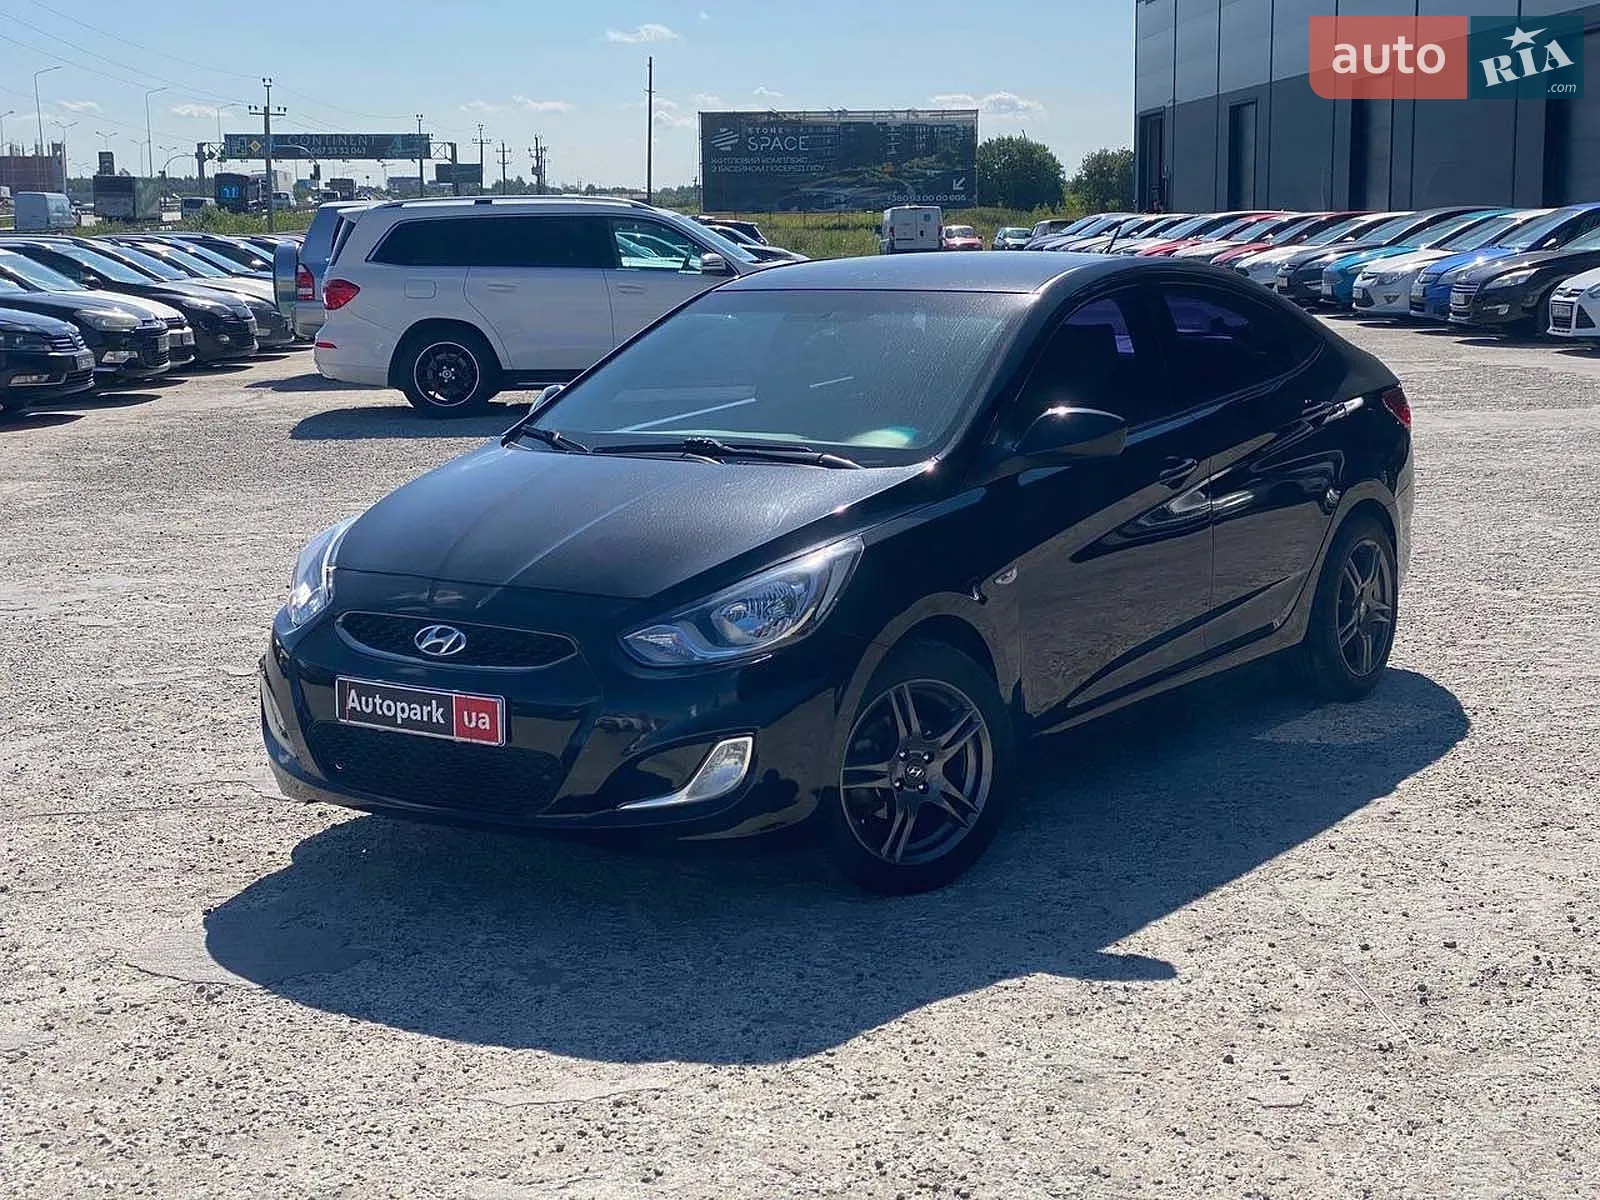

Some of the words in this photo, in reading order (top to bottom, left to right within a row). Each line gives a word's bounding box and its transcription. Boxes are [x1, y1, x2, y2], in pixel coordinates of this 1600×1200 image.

[287, 135, 376, 146] CONTINENT
[748, 136, 809, 151] SPACE
[347, 688, 445, 724] Autopark
[463, 710, 490, 730] ua
